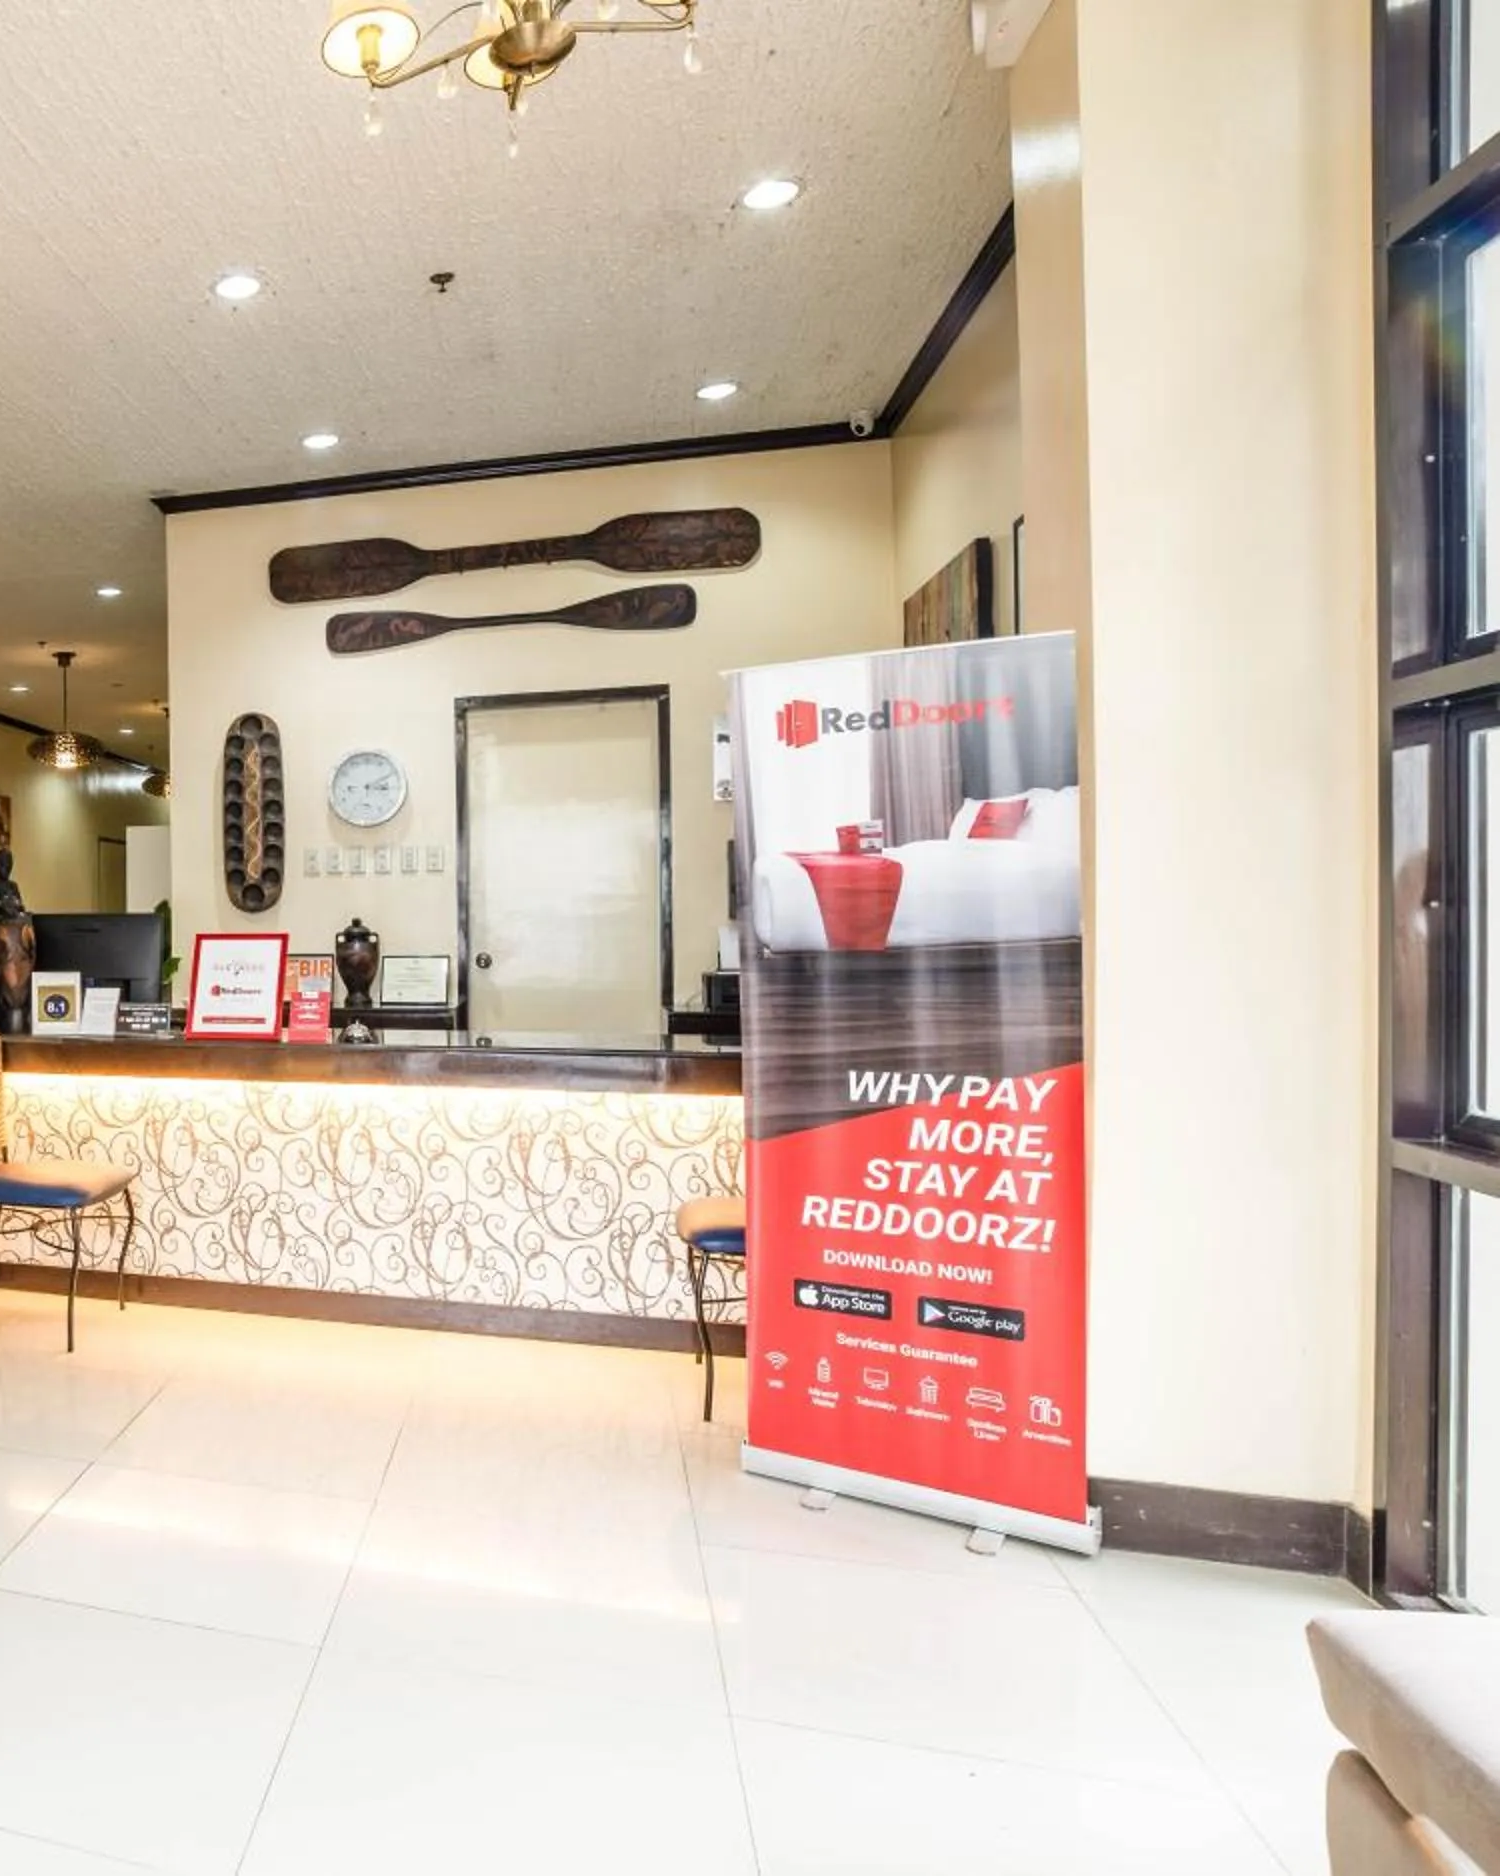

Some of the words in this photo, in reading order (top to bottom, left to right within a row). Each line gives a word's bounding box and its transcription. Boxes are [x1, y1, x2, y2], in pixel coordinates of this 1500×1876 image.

[848, 1070, 955, 1107] WHY
[957, 1076, 1058, 1112] PAY
[908, 1117, 1054, 1167] MORE,
[863, 1158, 979, 1198] STAY
[984, 1169, 1053, 1205] AT
[801, 1195, 1056, 1253] REDDOORZ!
[823, 1249, 932, 1276] DOWNLOAD
[937, 1264, 993, 1285] NOW!
[822, 1293, 850, 1310] App
[851, 1297, 886, 1314] Store
[948, 1311, 994, 1329] Google
[995, 1319, 1021, 1335] play
[836, 1332, 897, 1354] Services
[900, 1343, 978, 1367] Guarantee
